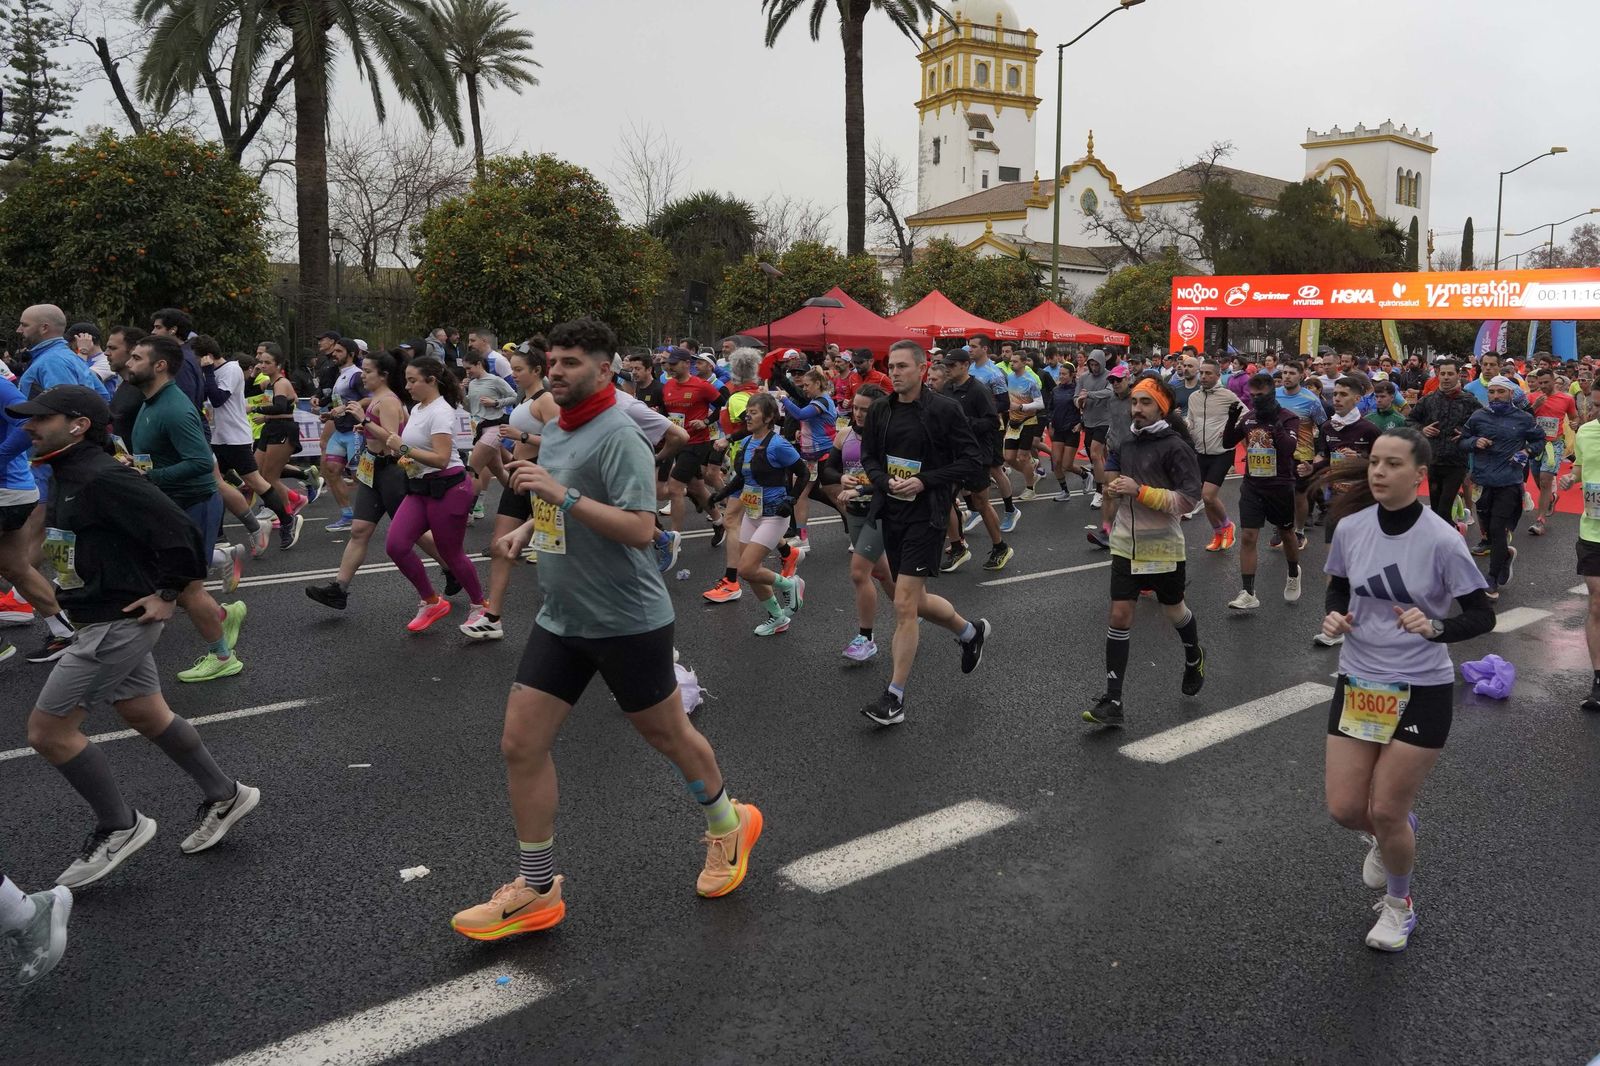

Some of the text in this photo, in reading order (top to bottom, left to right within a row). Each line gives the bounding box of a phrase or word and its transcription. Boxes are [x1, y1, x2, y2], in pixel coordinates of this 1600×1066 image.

[1331, 289, 1375, 304] HOKA
[1447, 281, 1520, 297] maratón
[1538, 288, 1600, 302] 00:11:16
[1252, 292, 1290, 302] Sprinter
[1462, 292, 1521, 308] sevilla
[1349, 691, 1398, 715] 13602
